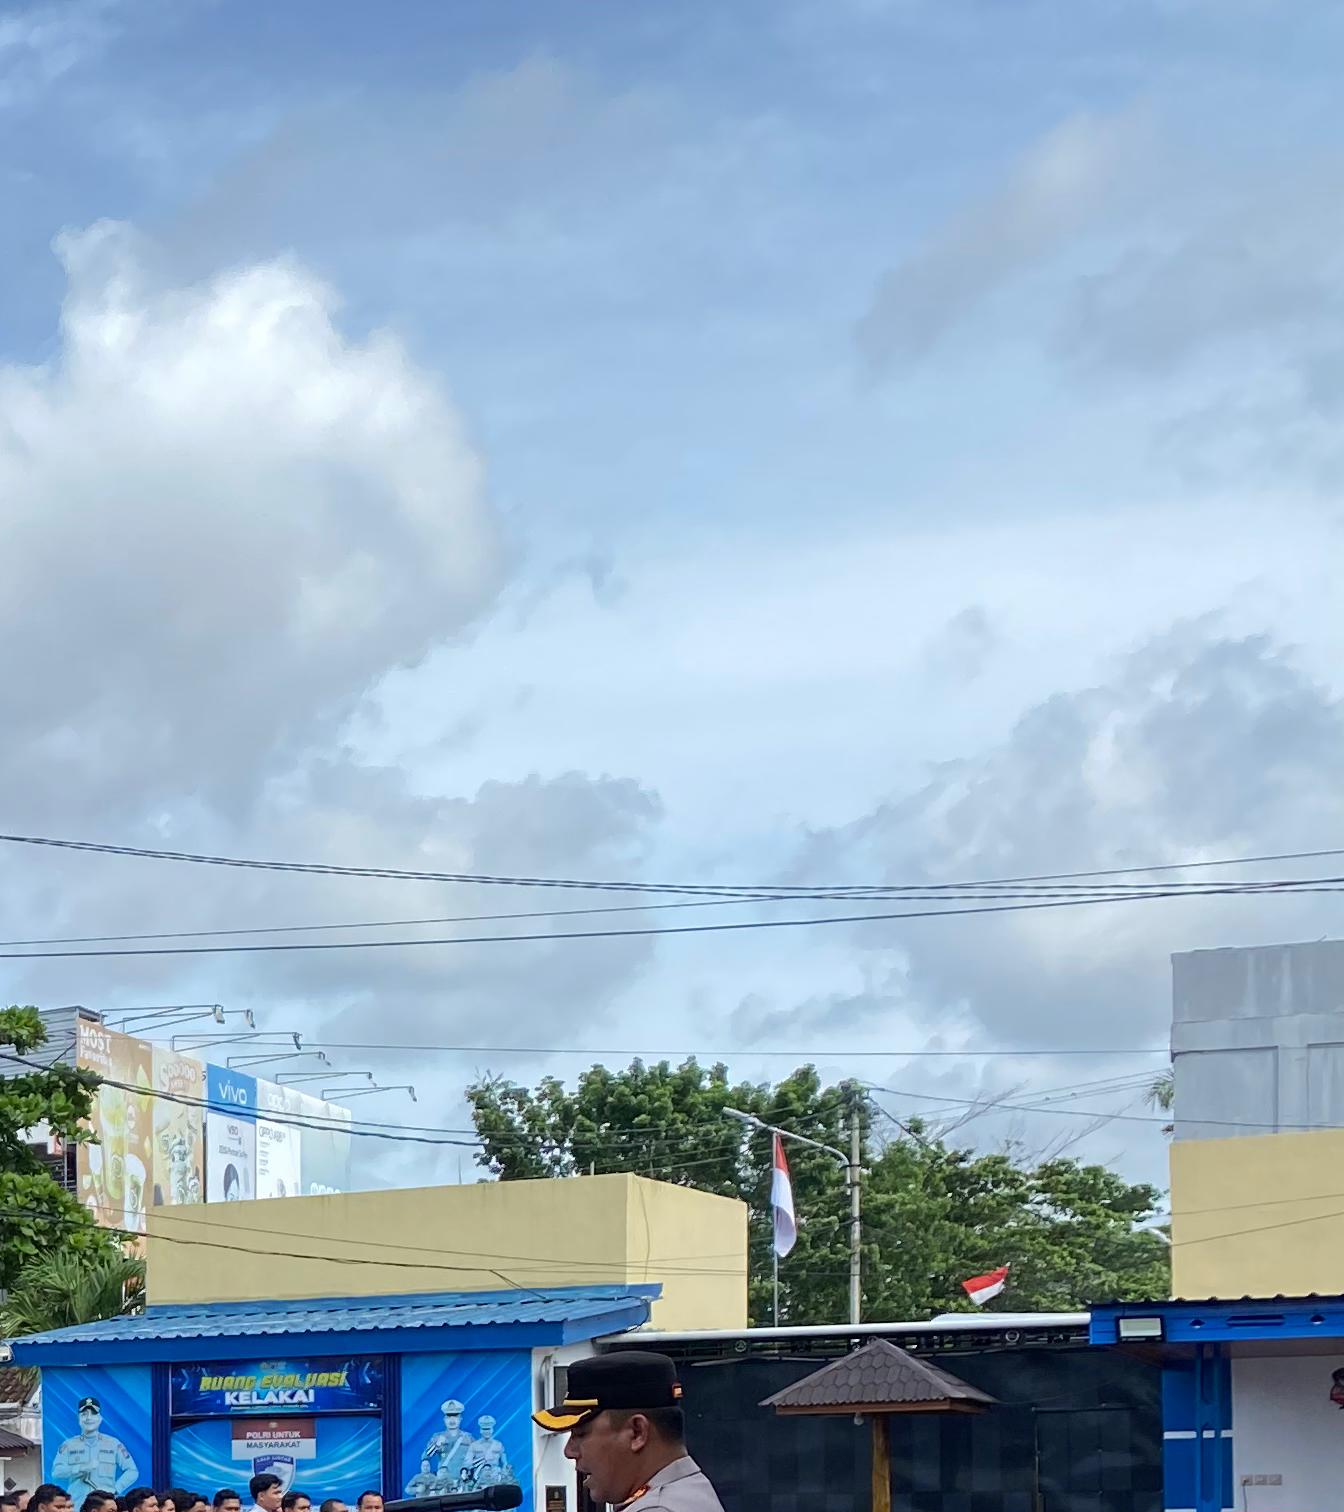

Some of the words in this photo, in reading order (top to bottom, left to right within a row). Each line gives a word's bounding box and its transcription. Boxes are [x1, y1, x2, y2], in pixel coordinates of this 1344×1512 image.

[219, 1079, 247, 1105] vivo
[200, 1375, 256, 1391] RUANG
[260, 1372, 348, 1389] EVALUASI
[225, 1389, 315, 1405] KELAKAI
[246, 1431, 272, 1439] POLRI
[273, 1430, 301, 1439] UNTUK
[246, 1440, 301, 1449] MASYARAKAT
